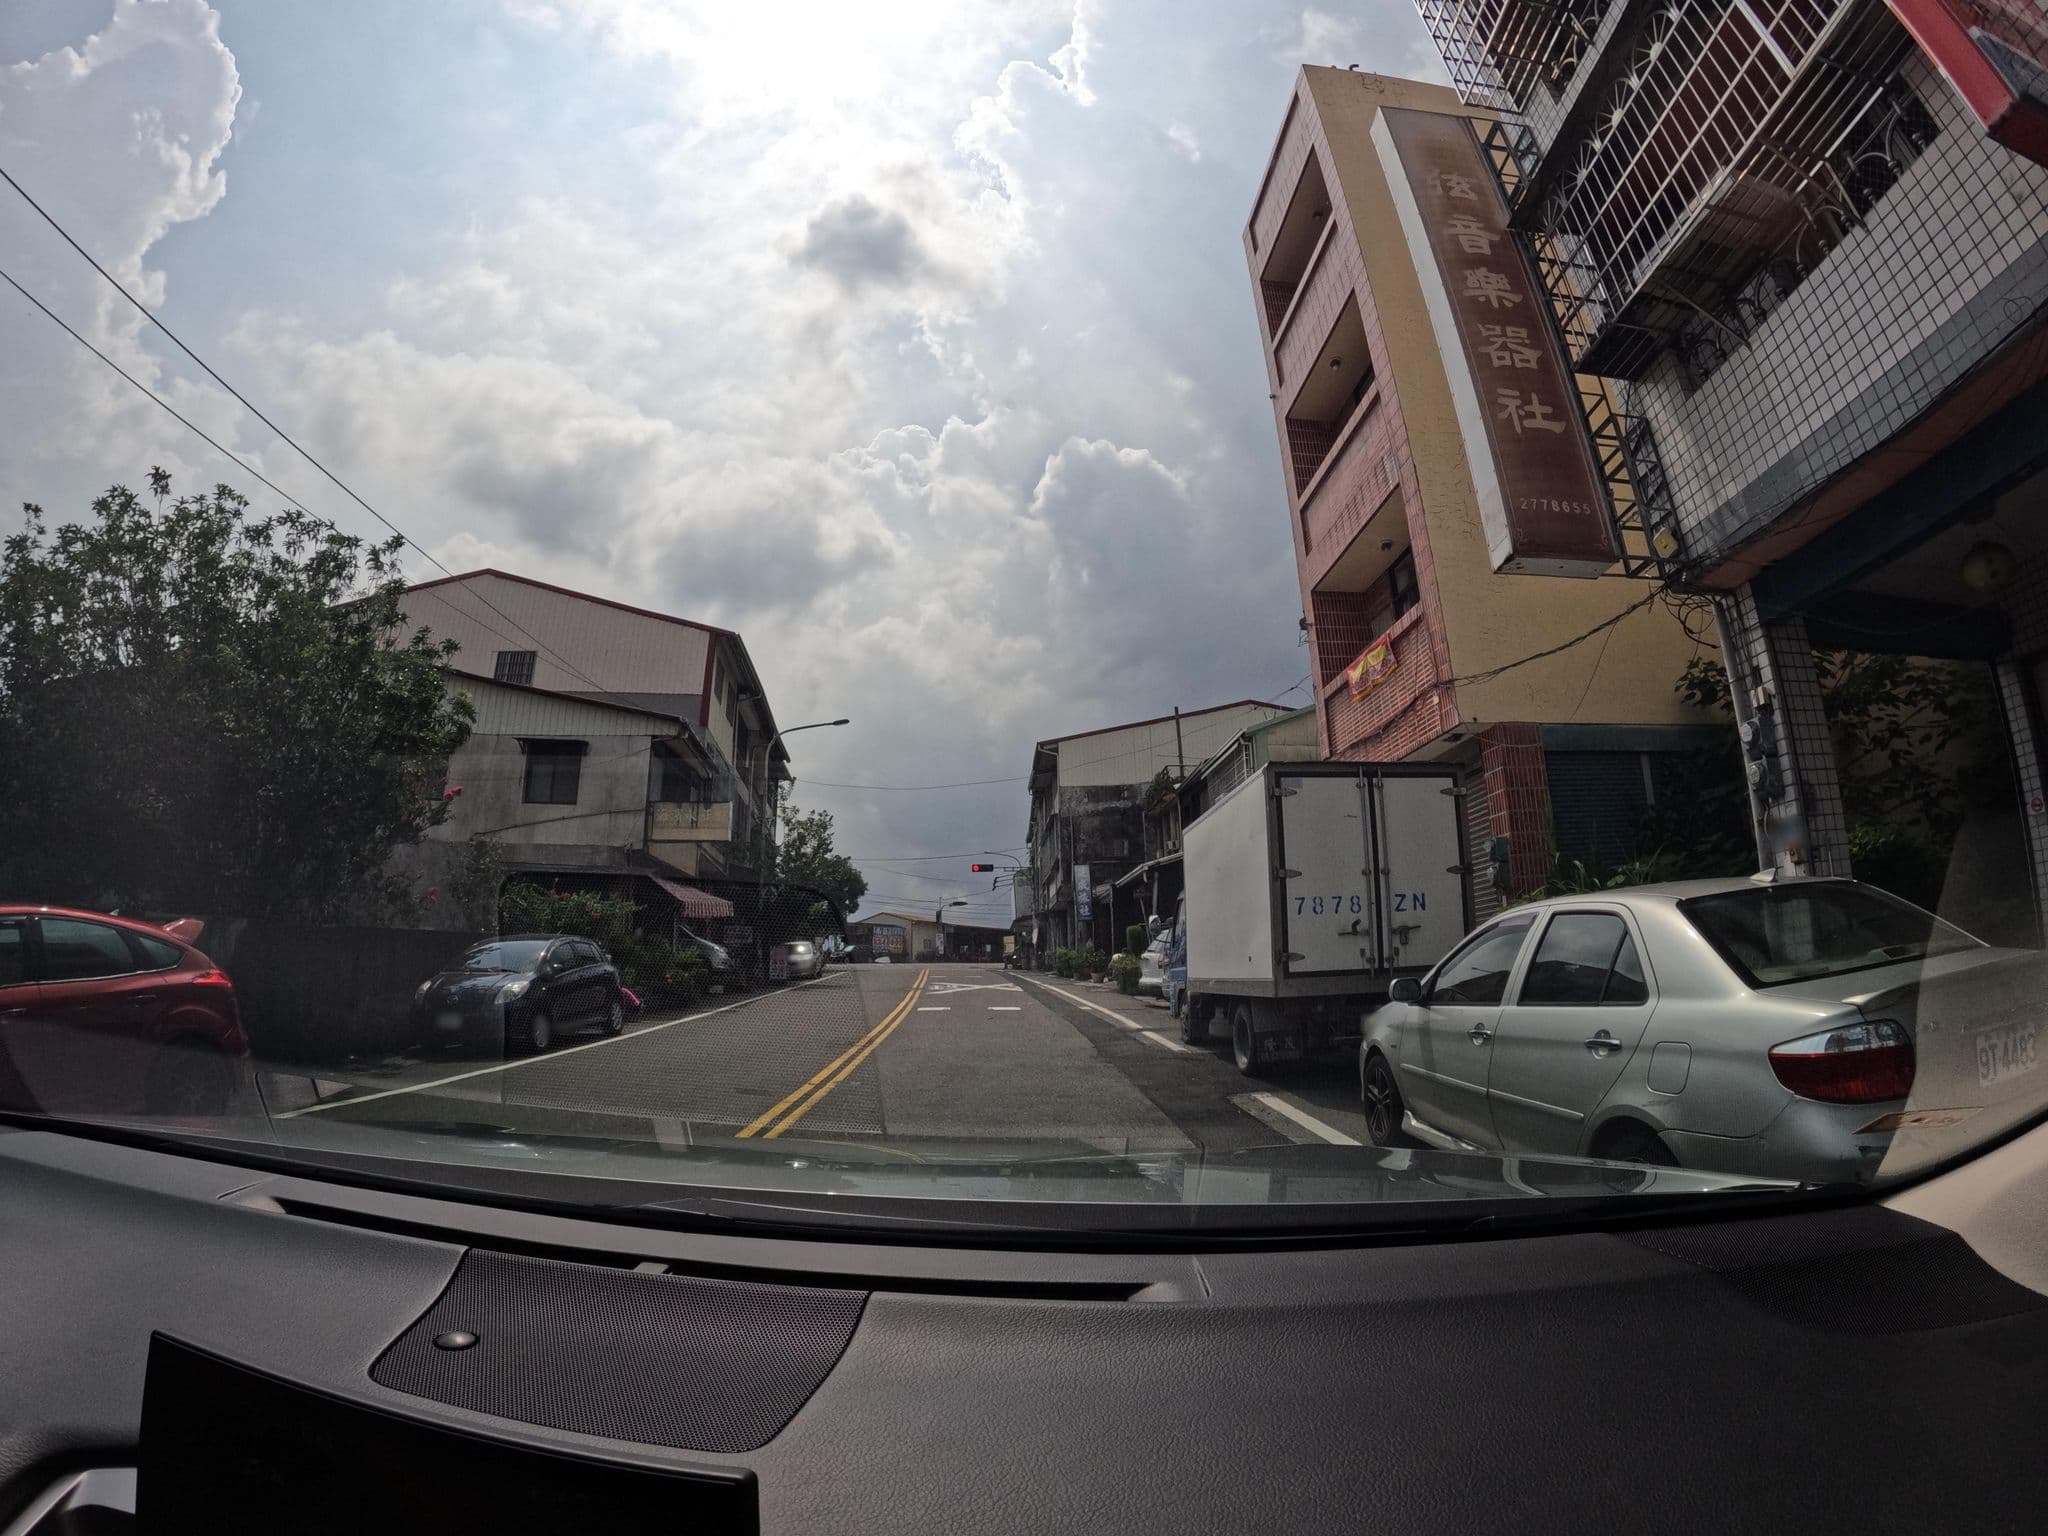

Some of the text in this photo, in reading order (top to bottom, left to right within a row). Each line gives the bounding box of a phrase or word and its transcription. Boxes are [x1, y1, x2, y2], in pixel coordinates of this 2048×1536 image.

[1519, 496, 1592, 516] 2778655
[1294, 893, 1426, 915] 7878 ZN
